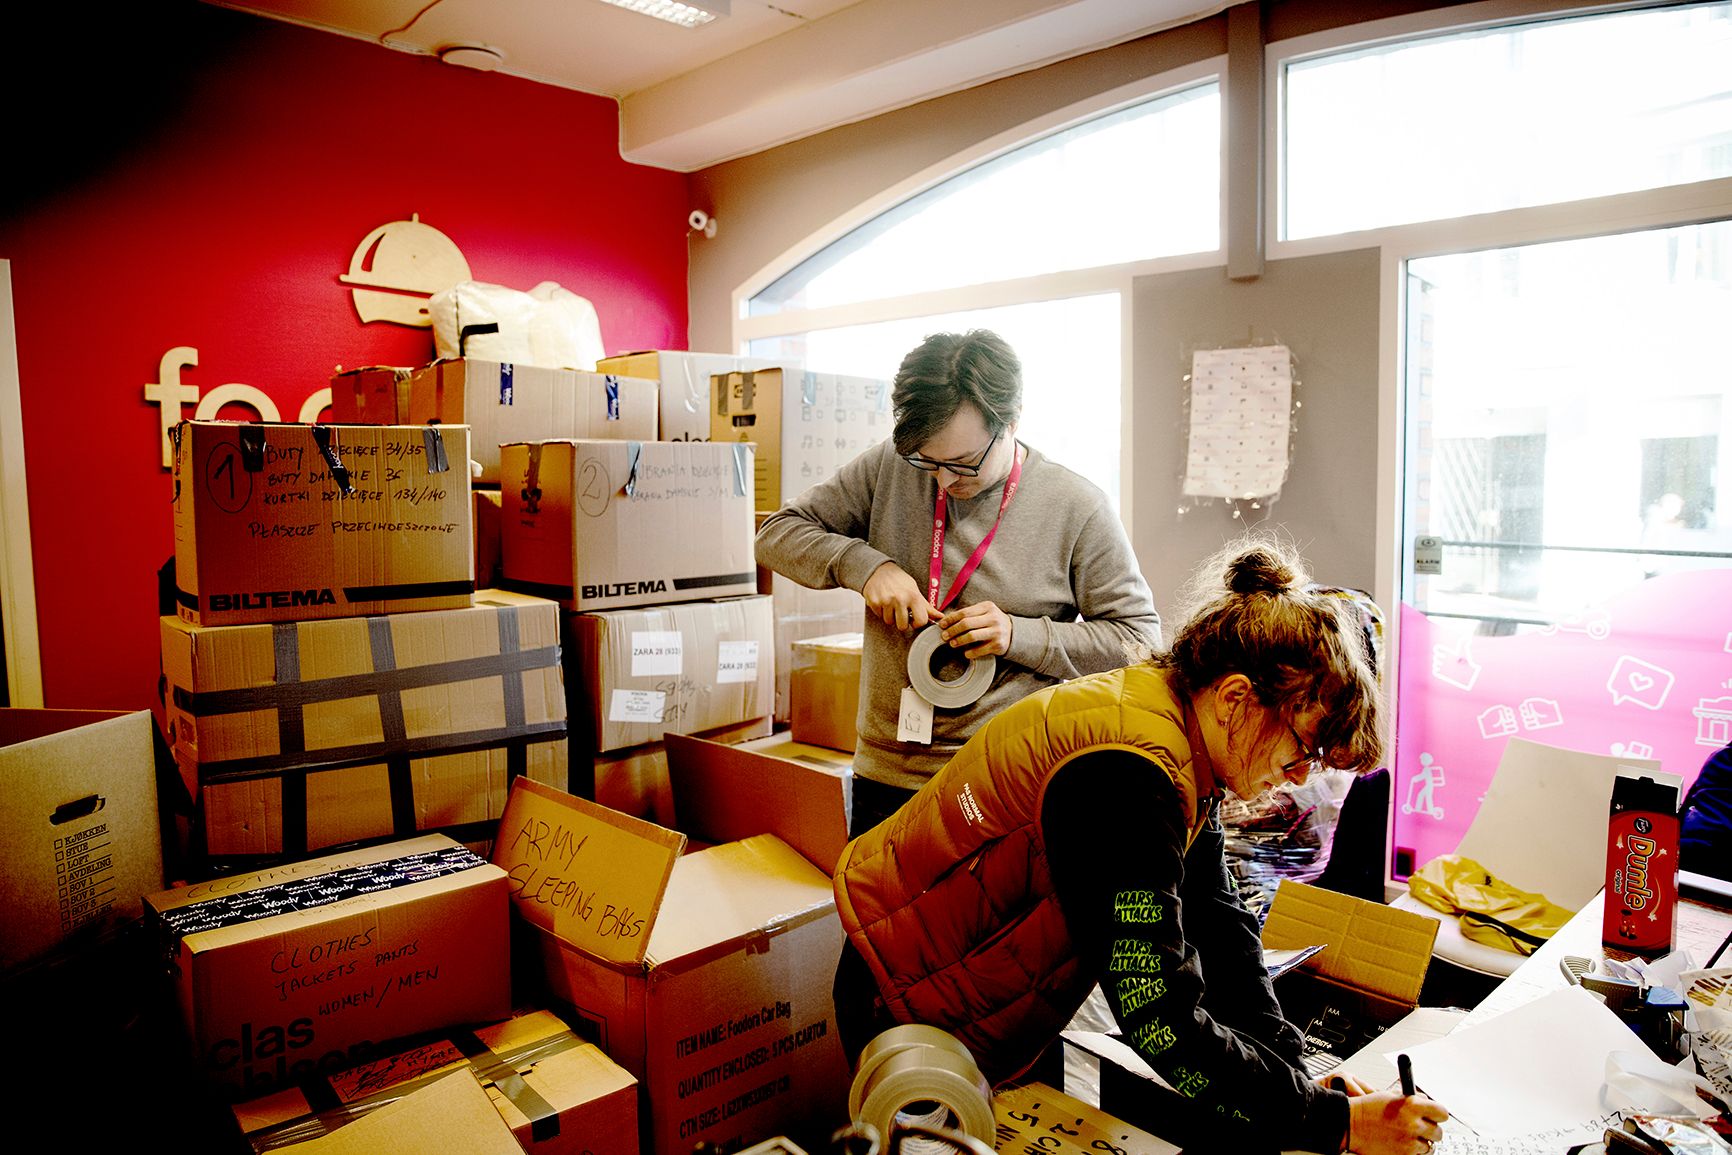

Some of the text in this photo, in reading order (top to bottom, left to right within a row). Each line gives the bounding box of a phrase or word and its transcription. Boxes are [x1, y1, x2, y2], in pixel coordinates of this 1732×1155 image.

[266, 444, 304, 470] BUTY
[386, 442, 426, 460] 34/35
[214, 454, 235, 500] 1
[268, 472, 301, 487] BUTY
[309, 470, 370, 484] DAKIE
[582, 464, 600, 499] 2
[264, 491, 310, 506] KURTKI
[394, 486, 447, 505] 134/140
[932, 528, 943, 559] foodora
[209, 588, 337, 612] BILTEMA
[582, 580, 667, 599] BILTEMA
[634, 648, 653, 656] ZARA
[960, 793, 974, 820] STUDIOS
[967, 794, 984, 823] NORMAL
[64, 823, 107, 845] KJØKKEN
[511, 817, 588, 871] ARMY
[66, 842, 89, 857] STUE
[67, 854, 90, 870] LOFT
[69, 858, 112, 881] AVDELING
[1624, 834, 1656, 910] Dumle
[70, 879, 87, 893] SOV
[261, 895, 300, 909] Woody
[318, 882, 355, 896] Woody
[371, 870, 407, 884] Woody
[1615, 869, 1623, 894] original
[71, 890, 87, 905] SOV
[72, 902, 89, 916] SOV
[507, 864, 645, 938] SLEEPING BAGS
[1115, 890, 1154, 907] MARS
[1114, 905, 1163, 923] ATTACKS
[271, 926, 376, 973] CLOTHES
[1112, 939, 1153, 956] MARS
[275, 939, 419, 1000] JACKETS PANTS
[1110, 955, 1161, 973] ATTACKS
[1328, 1007, 1340, 1016] AAA
[676, 1034, 698, 1059] ITEM
[699, 1024, 726, 1050] NAME:
[761, 1006, 774, 1024] Car
[776, 1001, 791, 1019] Bag
[207, 1018, 314, 1069] clas
[679, 1066, 720, 1098] QUANTITY
[722, 1046, 770, 1080] ENCLOSED:
[680, 1117, 698, 1139] CTN
